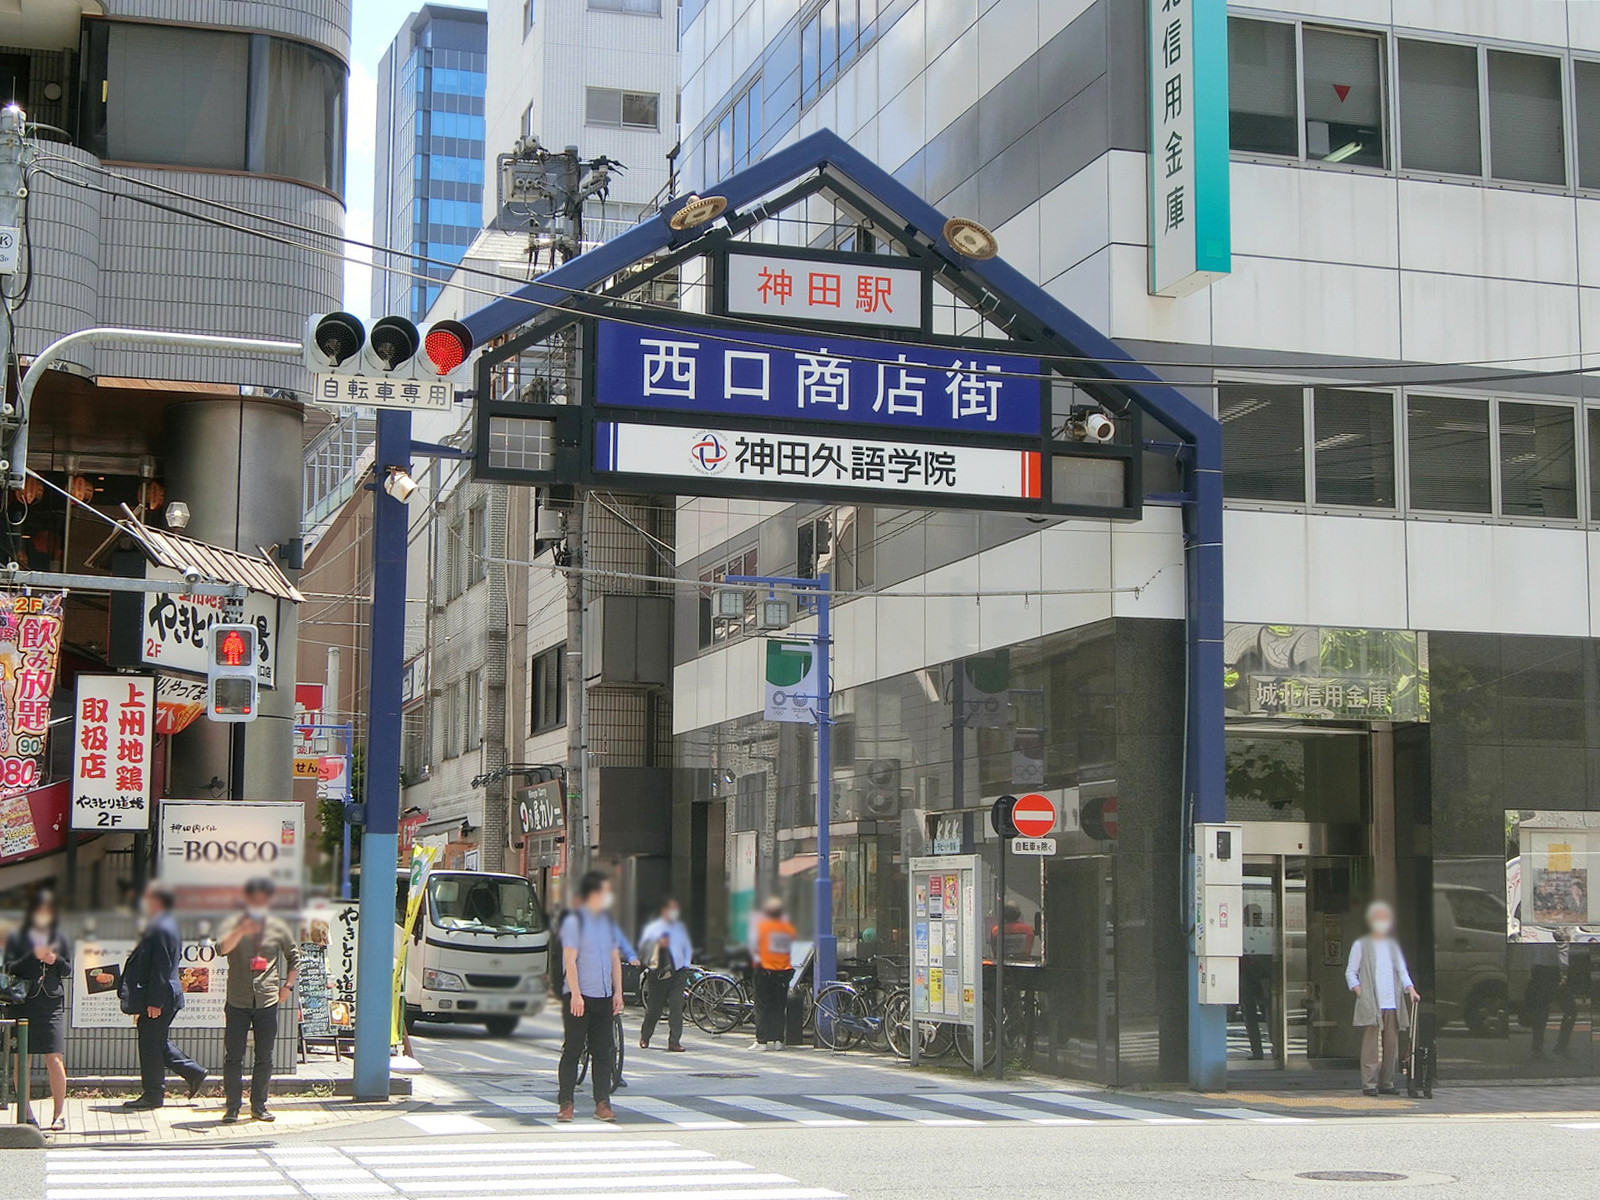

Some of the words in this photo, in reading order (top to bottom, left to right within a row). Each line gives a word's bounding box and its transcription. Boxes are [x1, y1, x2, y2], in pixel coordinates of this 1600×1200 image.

[1162, 0, 1185, 236] 信用金庫
[757, 266, 893, 314] 神田駅
[323, 377, 447, 406] 自転車専用
[640, 337, 1004, 421] 西口商店街
[735, 436, 957, 487] 神田外語学院
[14, 598, 43, 613] 2F
[146, 638, 162, 658] 2F
[15, 618, 58, 733] 飲み放題
[1256, 683, 1389, 709] 城北信用金庫
[80, 697, 109, 779] 取扱店
[115, 682, 146, 792] 上州地鶏
[76, 795, 145, 811] やきとり道場
[97, 812, 123, 826] 2F
[184, 840, 278, 862] BOSCO
[1015, 841, 1052, 852] 自転車を除く
